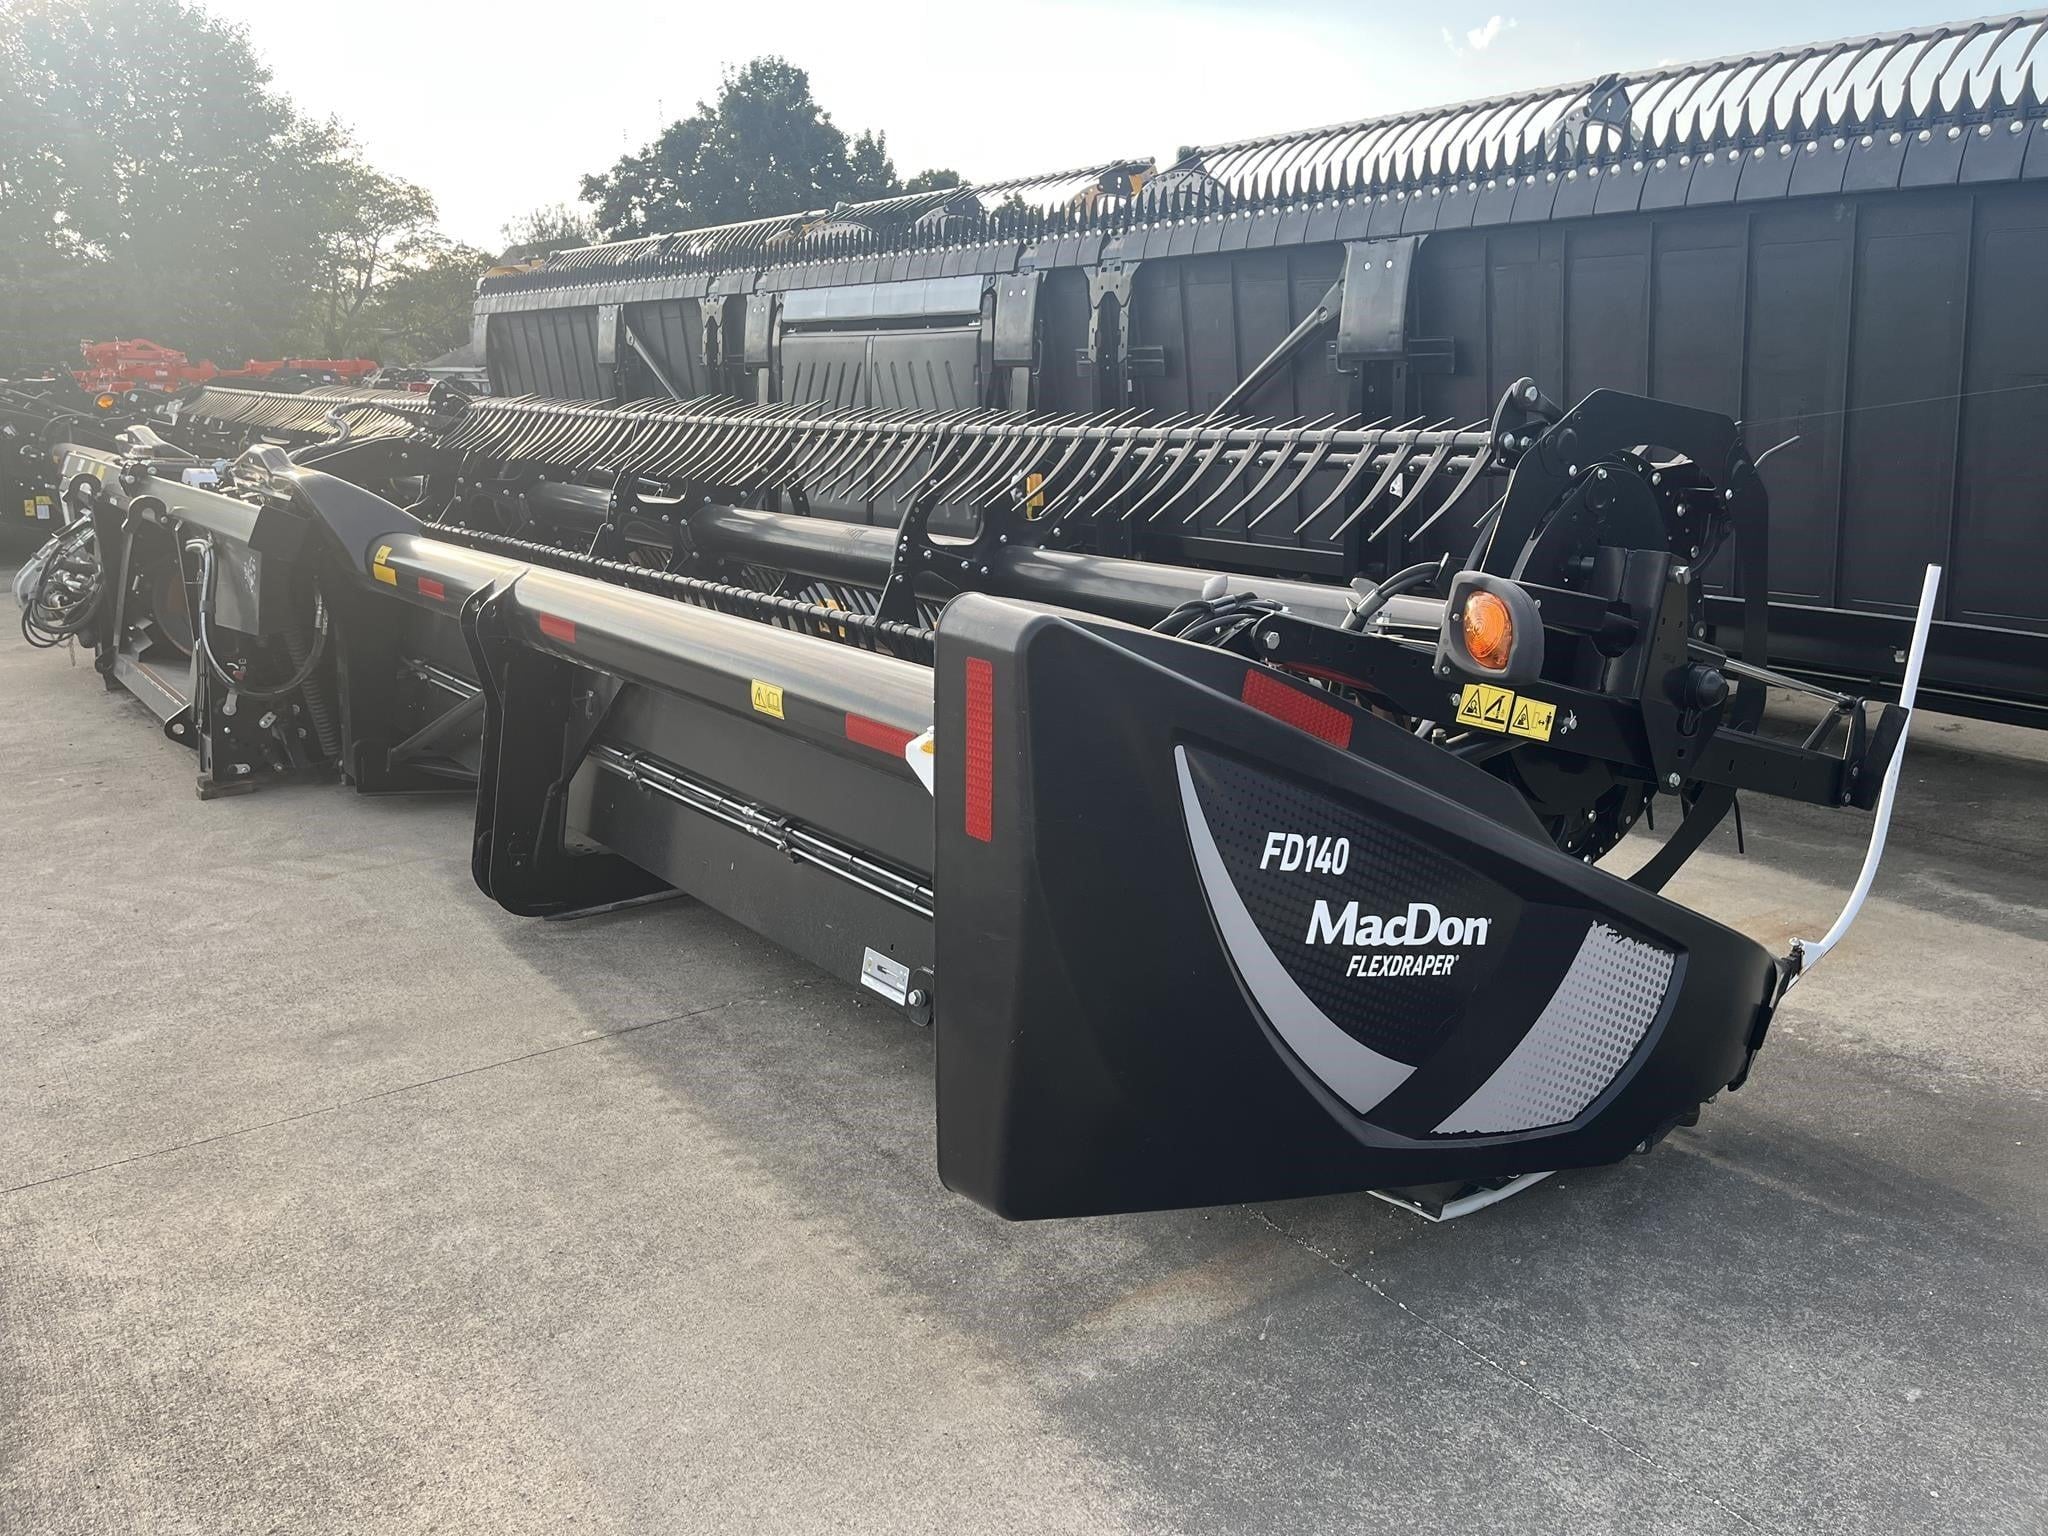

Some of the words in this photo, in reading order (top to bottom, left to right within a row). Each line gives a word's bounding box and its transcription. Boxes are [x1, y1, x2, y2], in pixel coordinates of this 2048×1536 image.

[1259, 831, 1350, 876] FD140
[1305, 899, 1489, 947] MacDon
[1345, 954, 1456, 977] FLEXDRAPER
